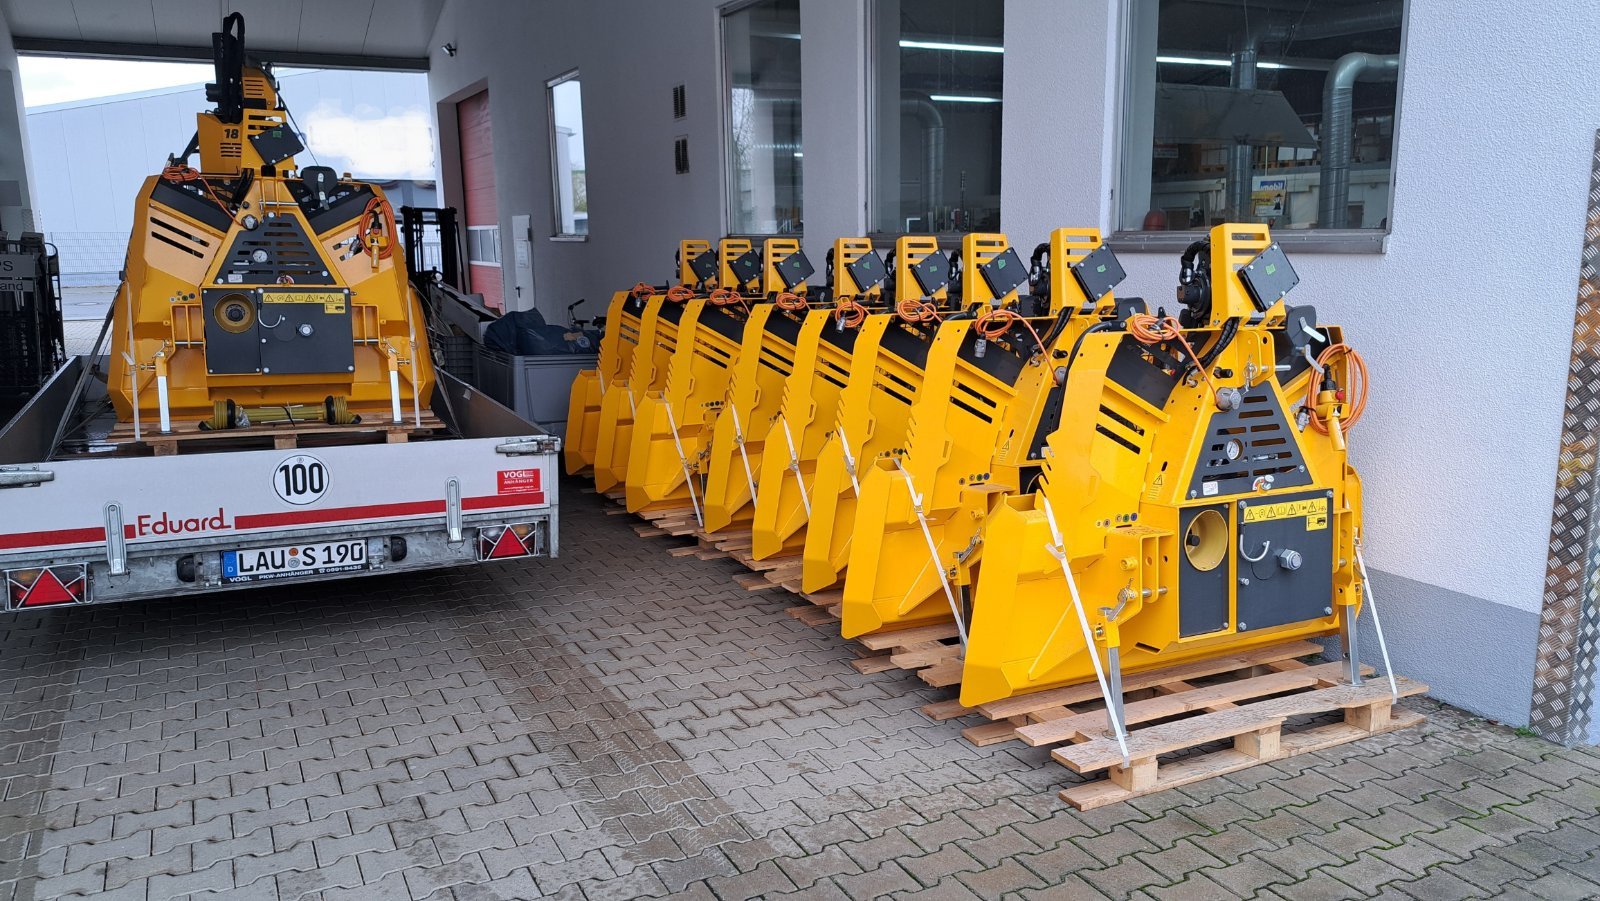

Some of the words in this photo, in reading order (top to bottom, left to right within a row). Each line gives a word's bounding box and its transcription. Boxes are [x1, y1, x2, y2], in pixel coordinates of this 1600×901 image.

[224, 128, 239, 139] 18
[279, 462, 324, 496] 100
[503, 470, 526, 478] VOGL
[138, 507, 231, 536] Eduard
[238, 550, 286, 573] LAU
[302, 547, 317, 567] S
[322, 542, 364, 565] 190
[229, 575, 253, 583] VOGL
[258, 569, 314, 579] PKW-ANHÄNGER
